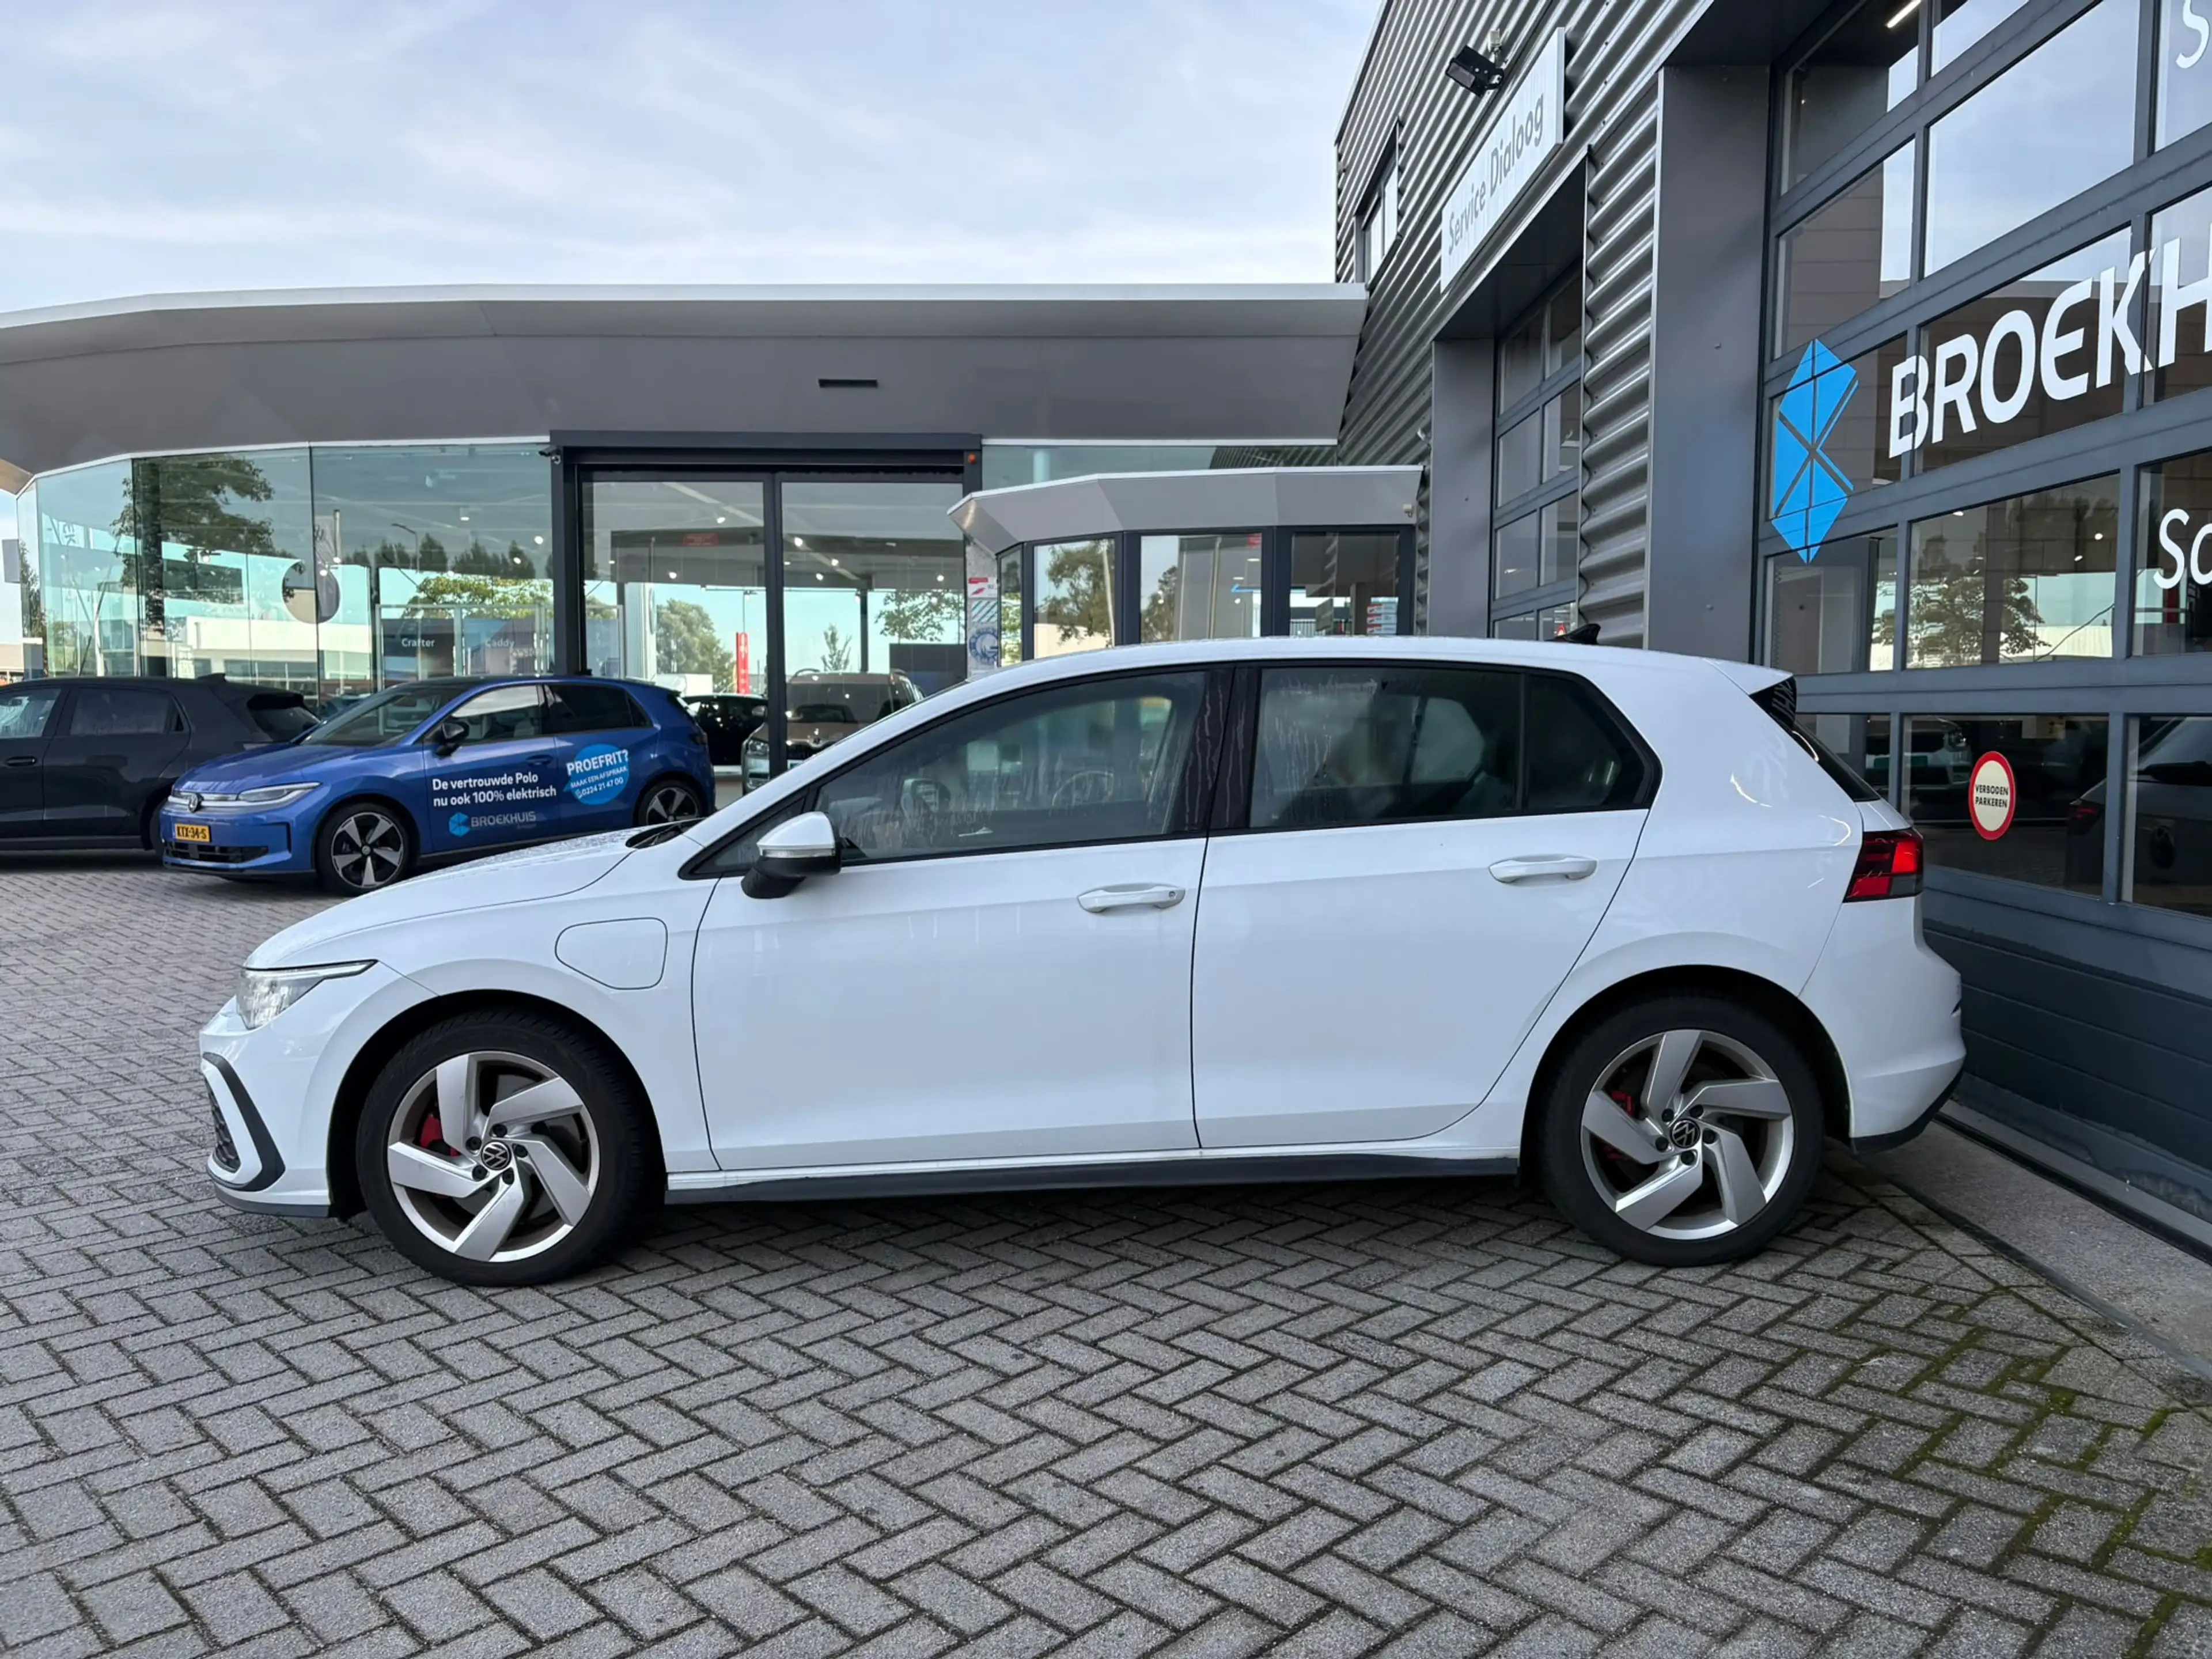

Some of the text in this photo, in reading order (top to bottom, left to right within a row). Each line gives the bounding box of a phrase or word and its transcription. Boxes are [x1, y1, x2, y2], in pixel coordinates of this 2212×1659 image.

[1449, 93, 1544, 256] Service Dialoog
[1889, 222, 2212, 459] BROEKH
[402, 638, 435, 647] Crafter
[566, 749, 628, 777] PROEFRIT?
[433, 771, 539, 790] De vertrouwde Polo
[1976, 784, 2009, 796] VERBODEN
[433, 785, 556, 807] nu ook 100% elektrisch
[1975, 796, 2008, 808] PARKEREN
[471, 811, 536, 827] BROEKHUIS
